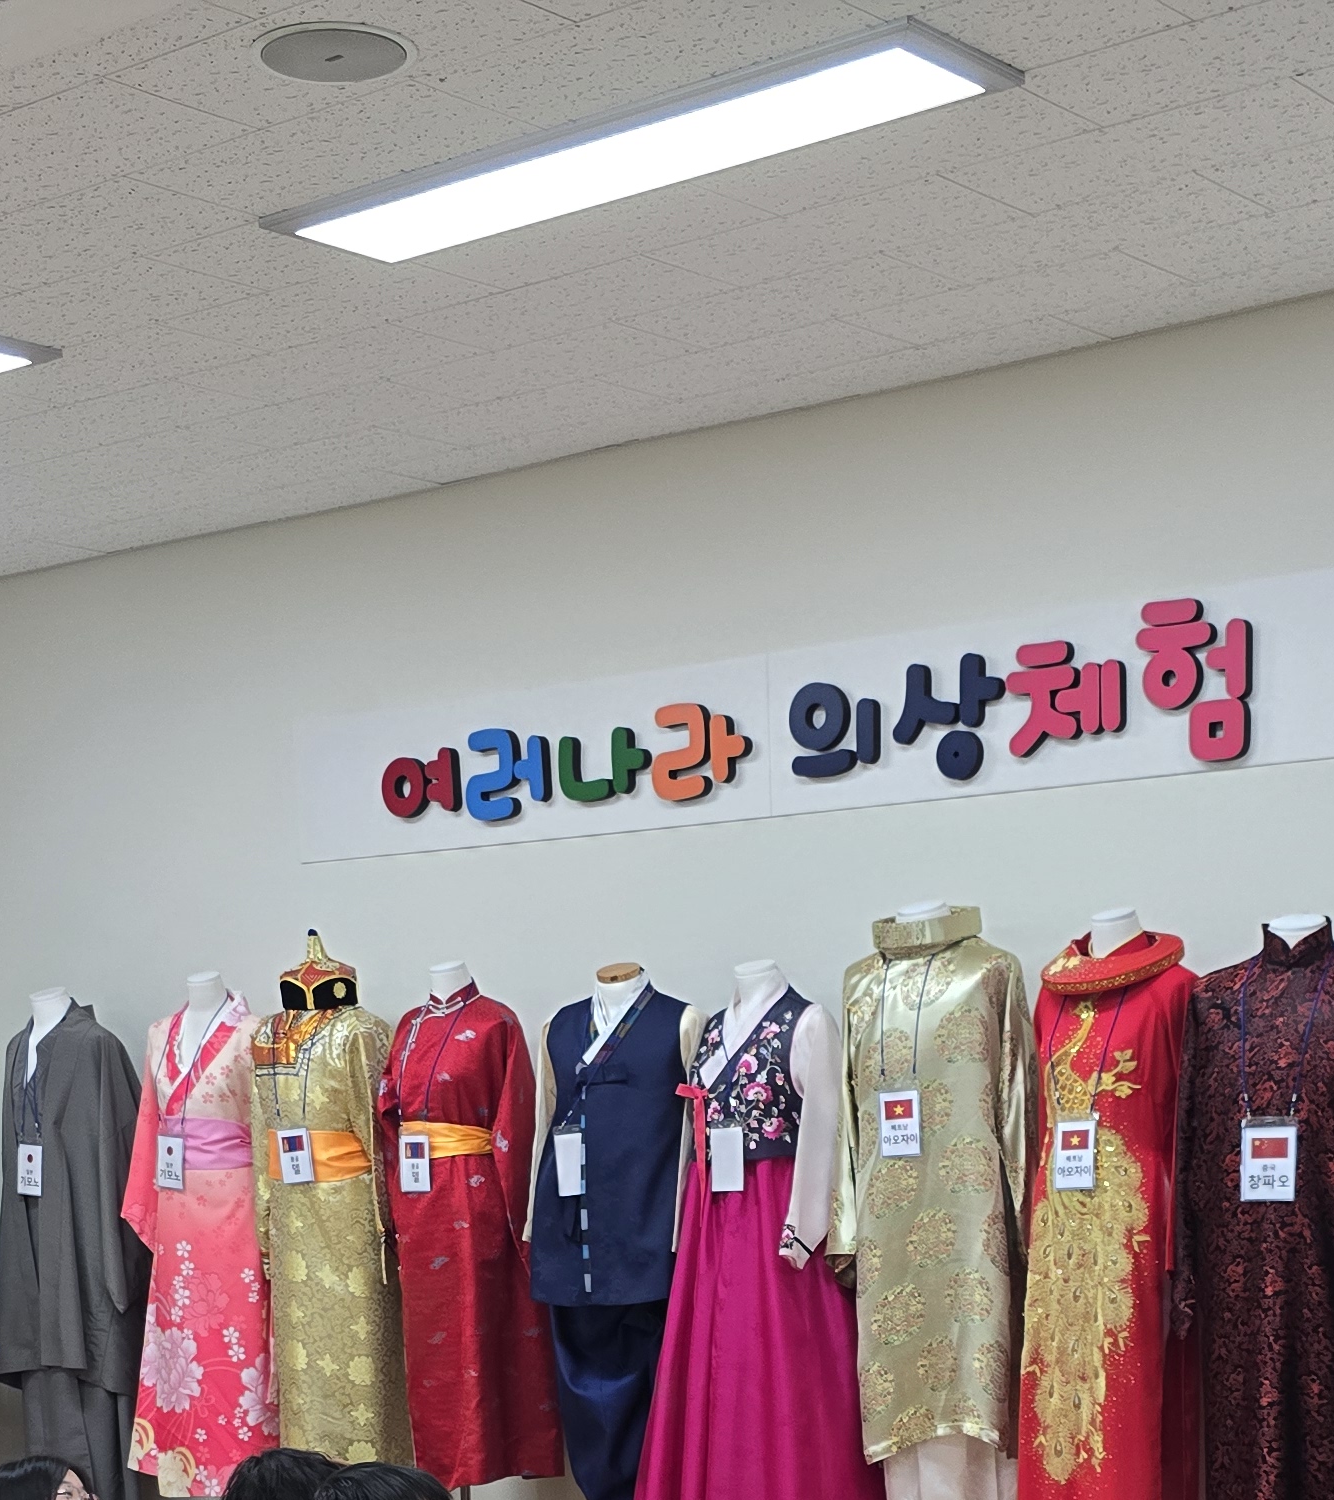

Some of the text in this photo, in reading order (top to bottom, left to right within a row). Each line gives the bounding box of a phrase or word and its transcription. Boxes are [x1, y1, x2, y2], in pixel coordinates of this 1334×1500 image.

[382, 703, 753, 821] 여러나라
[883, 1133, 918, 1146] 아오자이
[160, 1169, 181, 1181] 기모노
[1057, 1165, 1091, 1177] 아오자이
[21, 1176, 39, 1187] 기모노
[1249, 1175, 1290, 1189] 창파오
